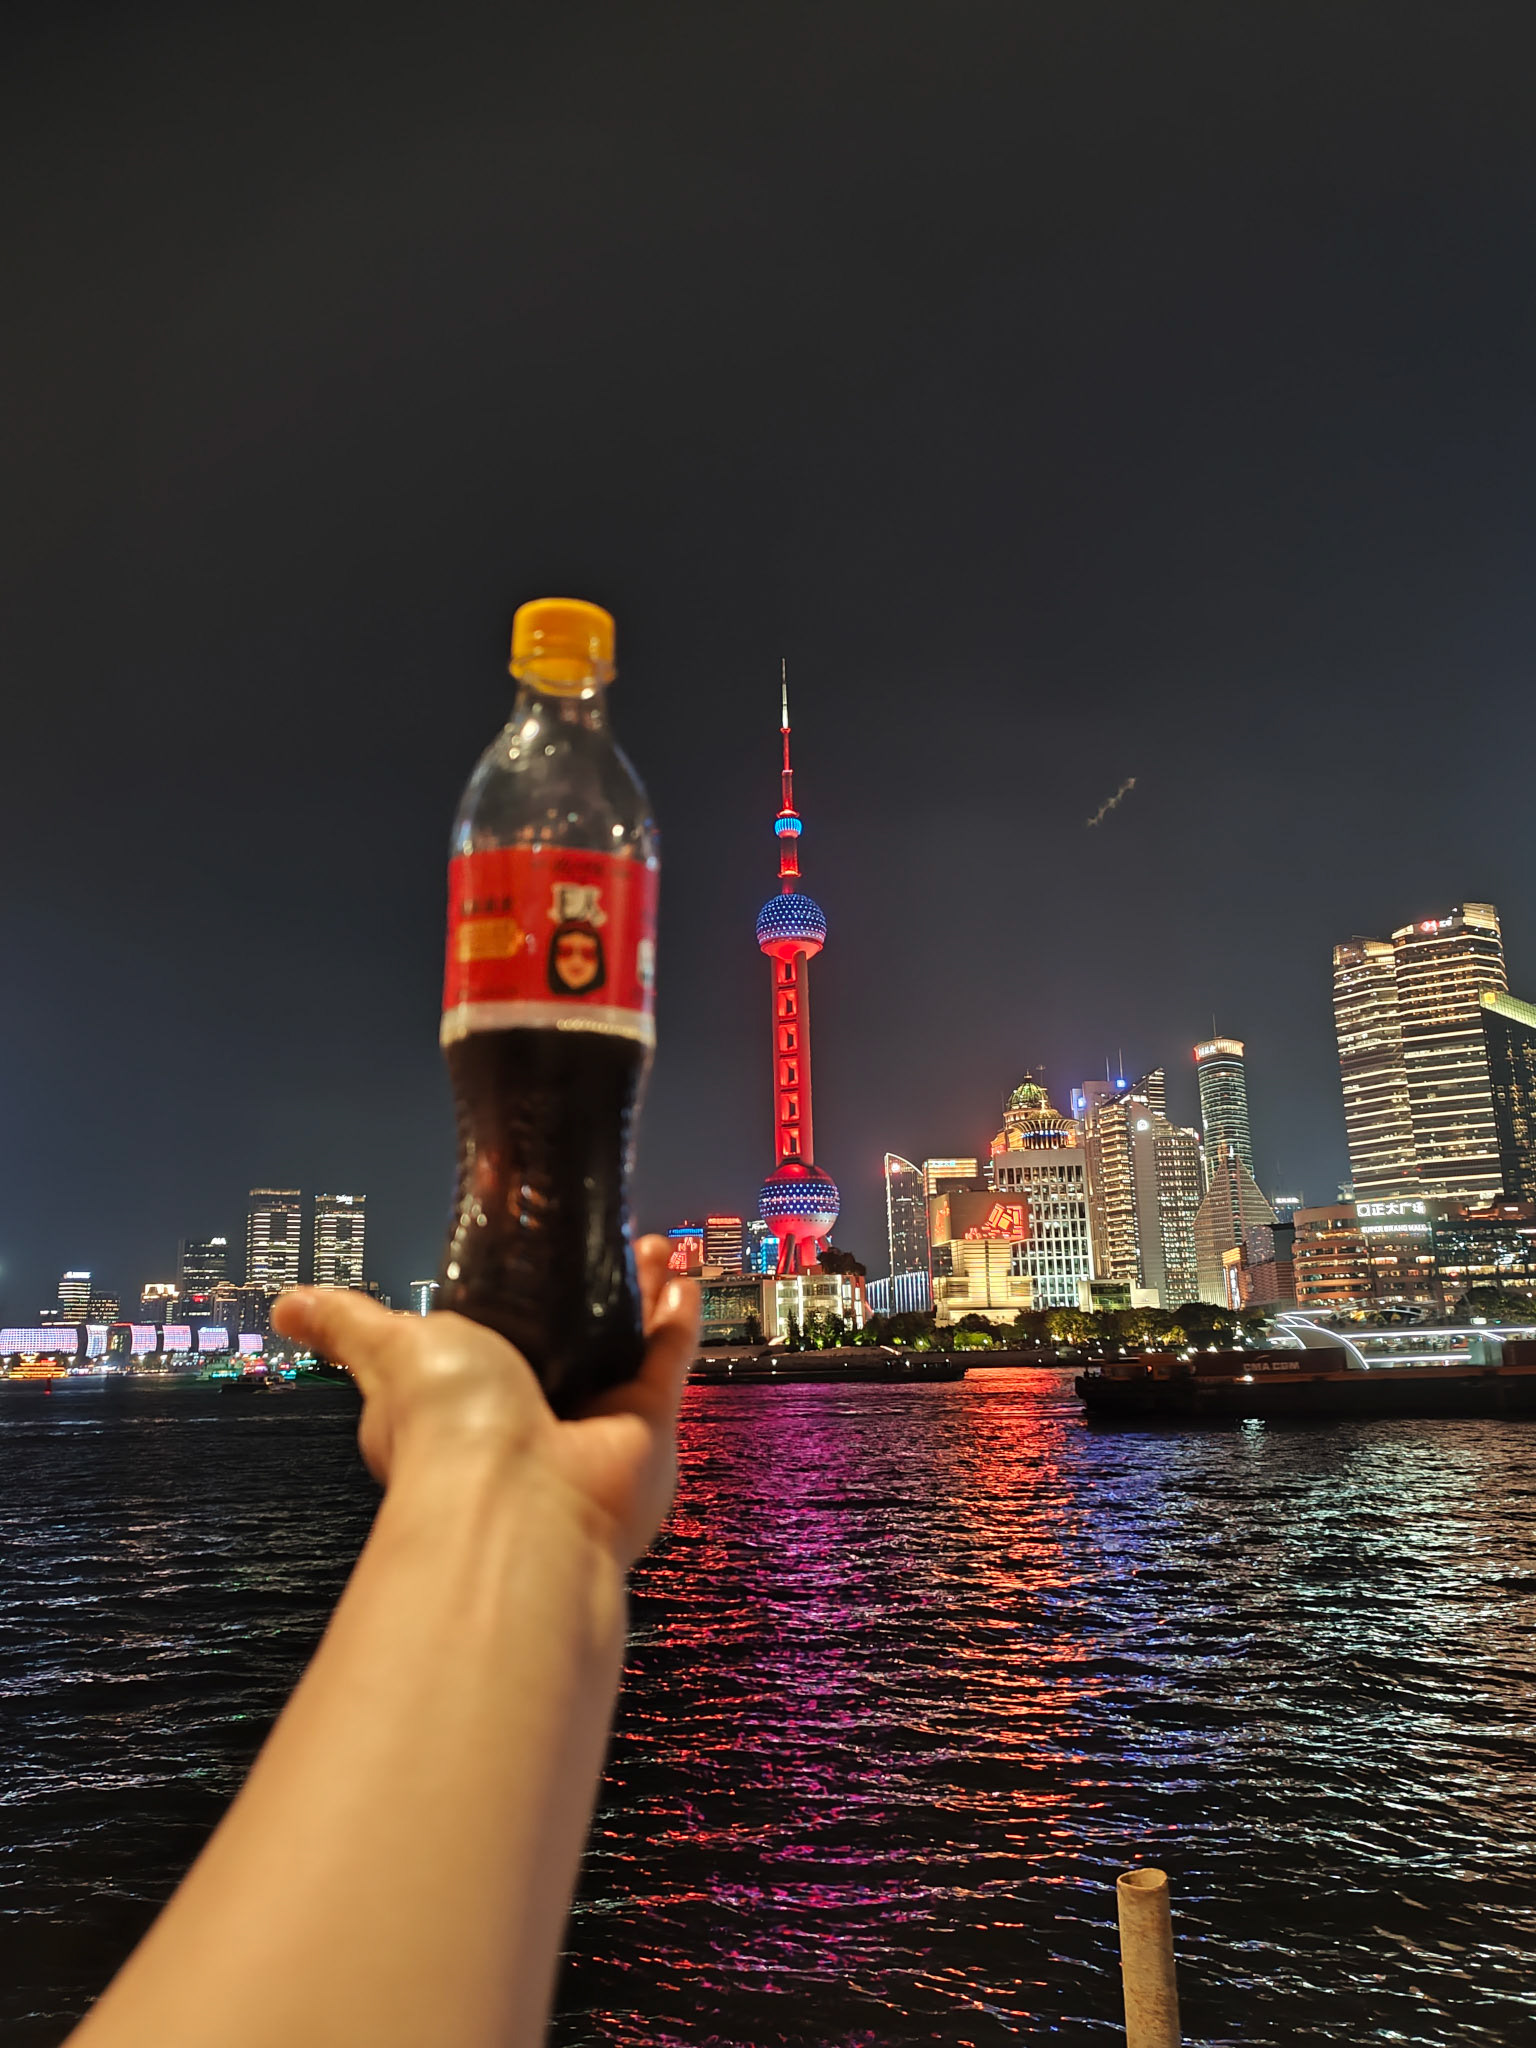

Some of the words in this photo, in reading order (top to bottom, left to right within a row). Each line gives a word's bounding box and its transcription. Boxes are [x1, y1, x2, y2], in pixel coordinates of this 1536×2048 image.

[1372, 1202, 1426, 1216] 正大广场
[1384, 1225, 1408, 1233] BRAND
